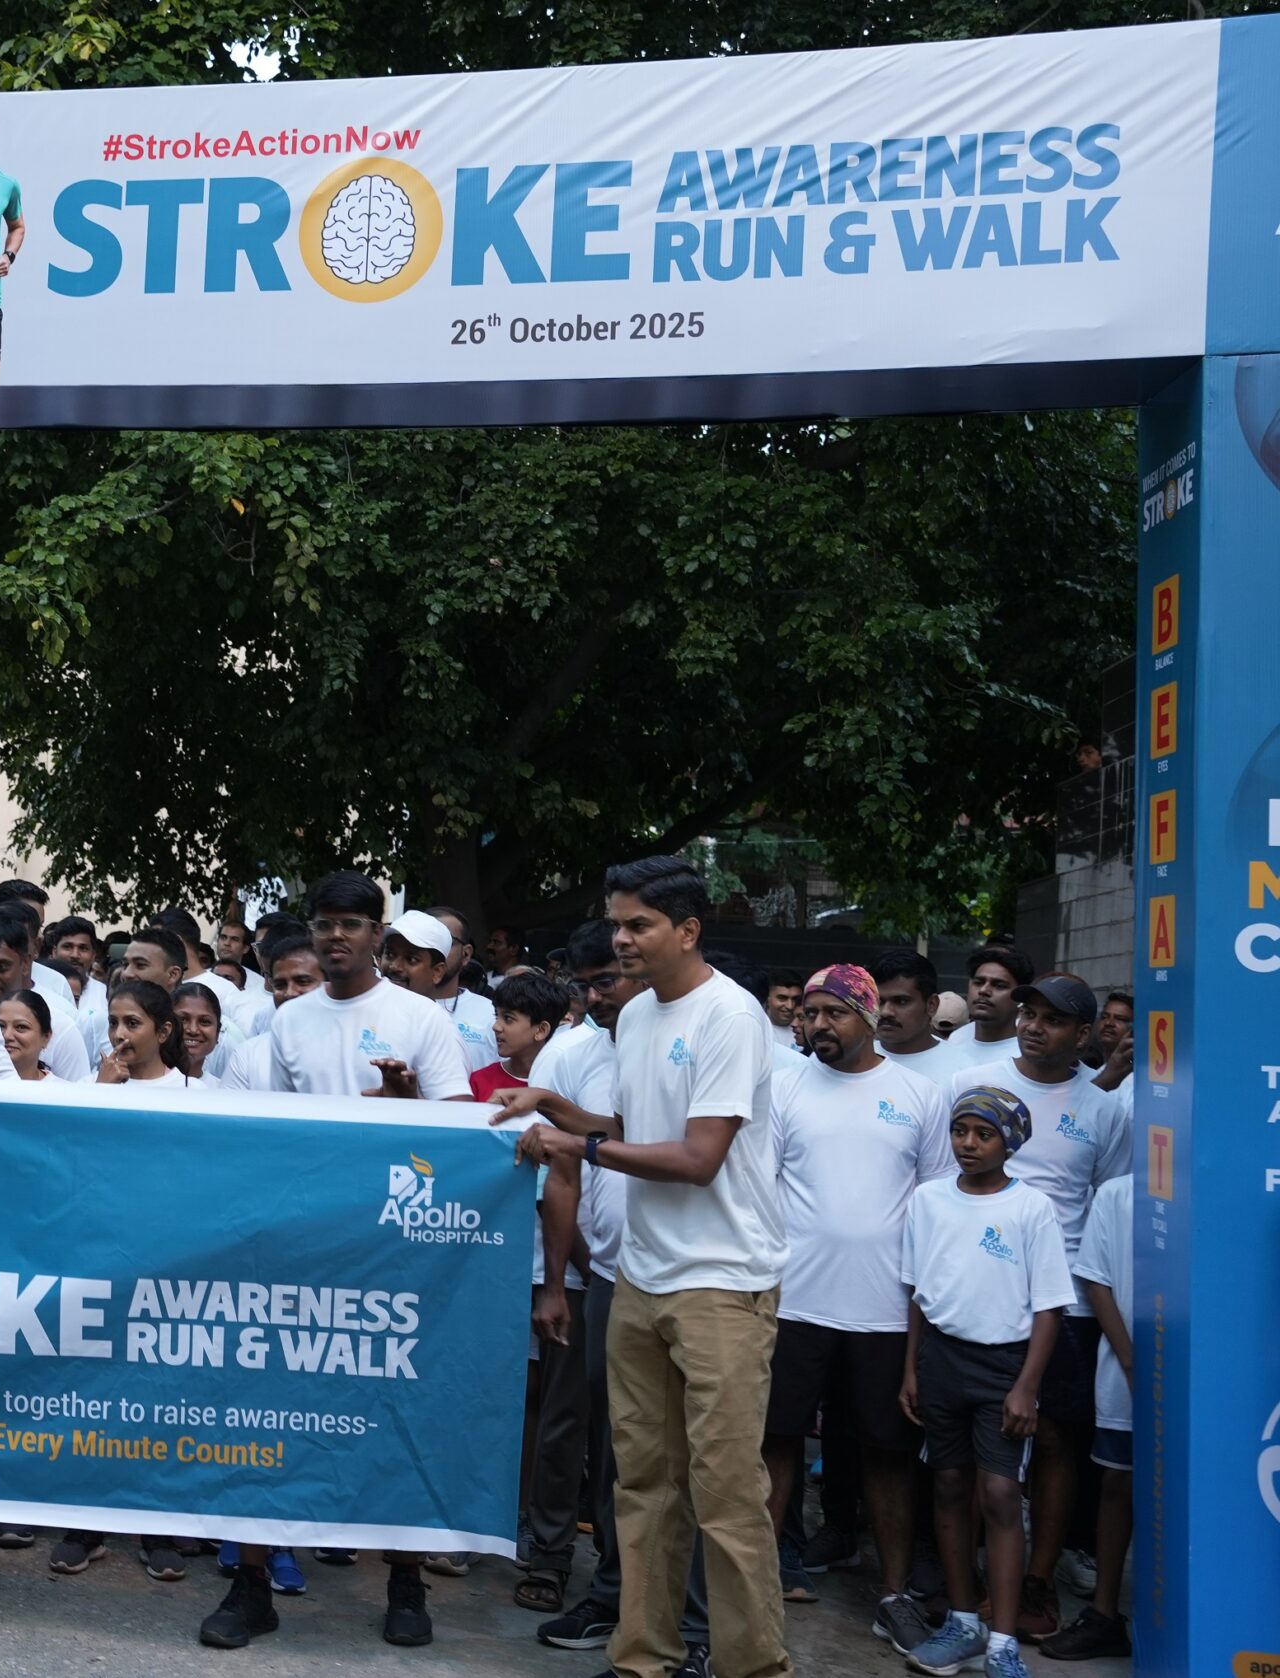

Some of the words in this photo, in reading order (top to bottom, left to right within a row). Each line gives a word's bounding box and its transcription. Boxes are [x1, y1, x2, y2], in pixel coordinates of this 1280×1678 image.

[103, 126, 421, 162] #StrokeActionNow
[657, 123, 1121, 213] AWARENESS
[47, 157, 632, 303] STROKE
[653, 215, 805, 283] RUN
[823, 211, 875, 275] &
[892, 197, 1121, 272] WALK
[451, 314, 501, 346] 26th
[509, 315, 620, 344] October
[629, 311, 705, 340] 2025
[1187, 441, 1196, 461] TO
[1157, 586, 1173, 646] B
[1157, 691, 1170, 749] E
[1156, 799, 1169, 857] F
[1153, 904, 1171, 960] A
[1155, 1017, 1168, 1076] S
[877, 1111, 911, 1123] Apollo
[1056, 1123, 1089, 1138] Apollo
[1153, 1133, 1168, 1191] T
[378, 1198, 481, 1238] Apollo
[410, 1229, 504, 1246] HOSPITALS
[978, 1238, 1013, 1256] Apollo
[128, 1278, 420, 1334] AWARENESS
[127, 1322, 225, 1368] RUN
[236, 1327, 269, 1369] &
[279, 1329, 419, 1379] WALK
[4, 1389, 110, 1422] together
[120, 1398, 145, 1423] to
[154, 1399, 217, 1426] raise
[225, 1407, 378, 1436] awareness-
[73, 1430, 168, 1460] Minute
[176, 1435, 284, 1468] Counts!
